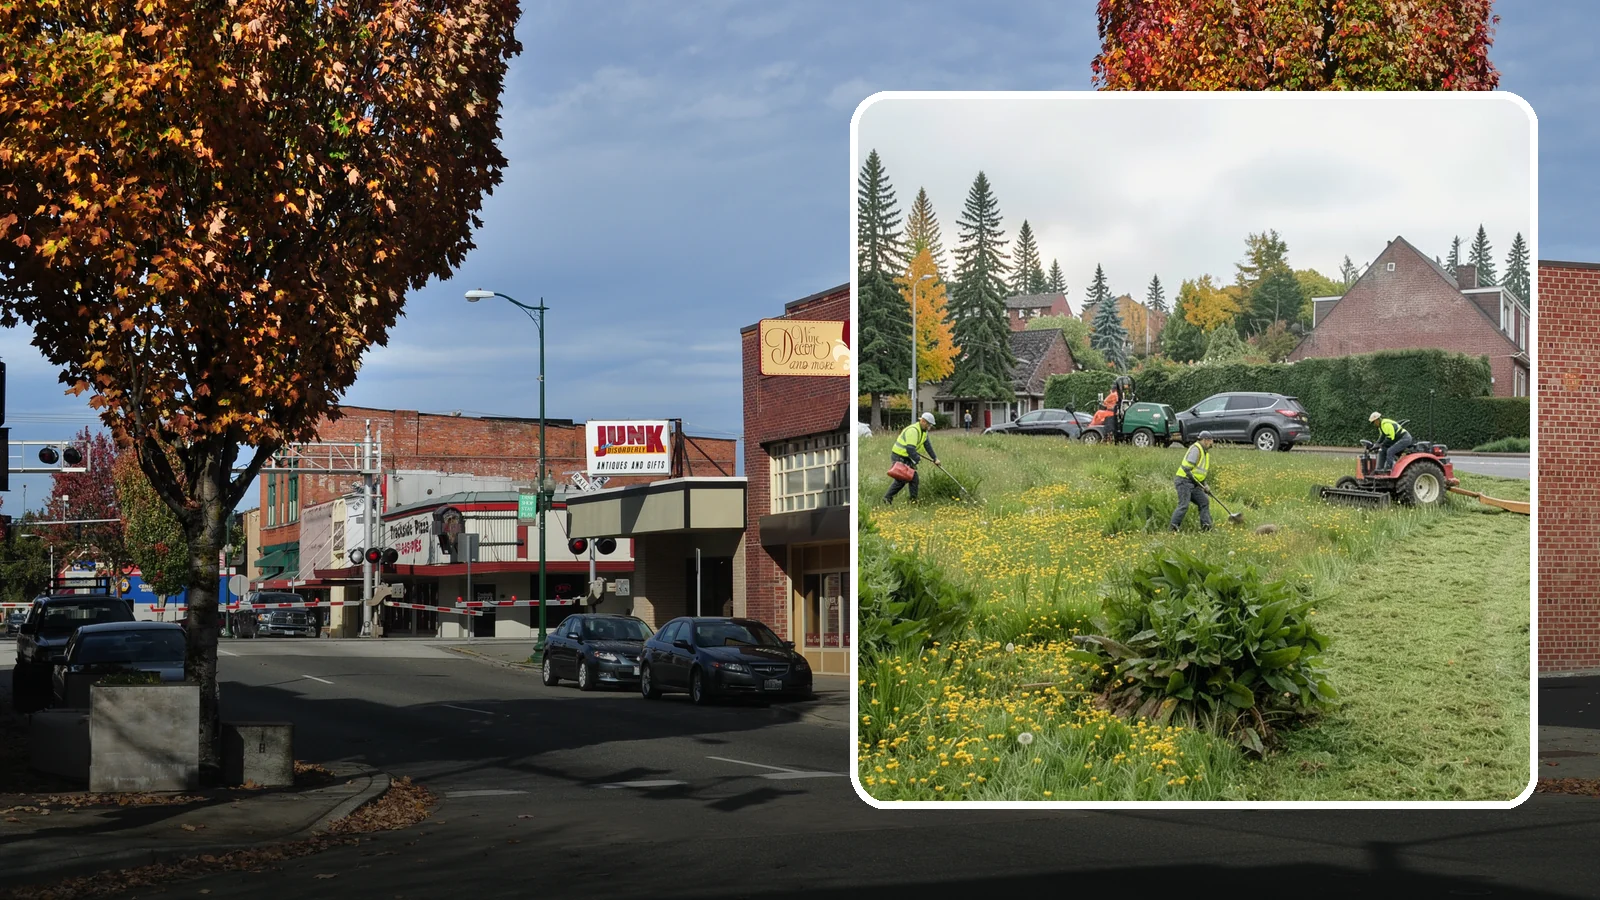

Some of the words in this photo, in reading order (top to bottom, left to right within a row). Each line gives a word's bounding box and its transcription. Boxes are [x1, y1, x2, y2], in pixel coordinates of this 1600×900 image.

[595, 425, 665, 457] JUNK
[607, 446, 645, 454] DISORDERLY
[597, 461, 628, 470] ANTIQUES
[631, 461, 644, 469] AND
[646, 460, 665, 469] GIFTS
[573, 473, 588, 490] RAIL
[352, 498, 365, 511] CRO
[390, 521, 412, 539] Trackside
[414, 519, 429, 535] Pizza
